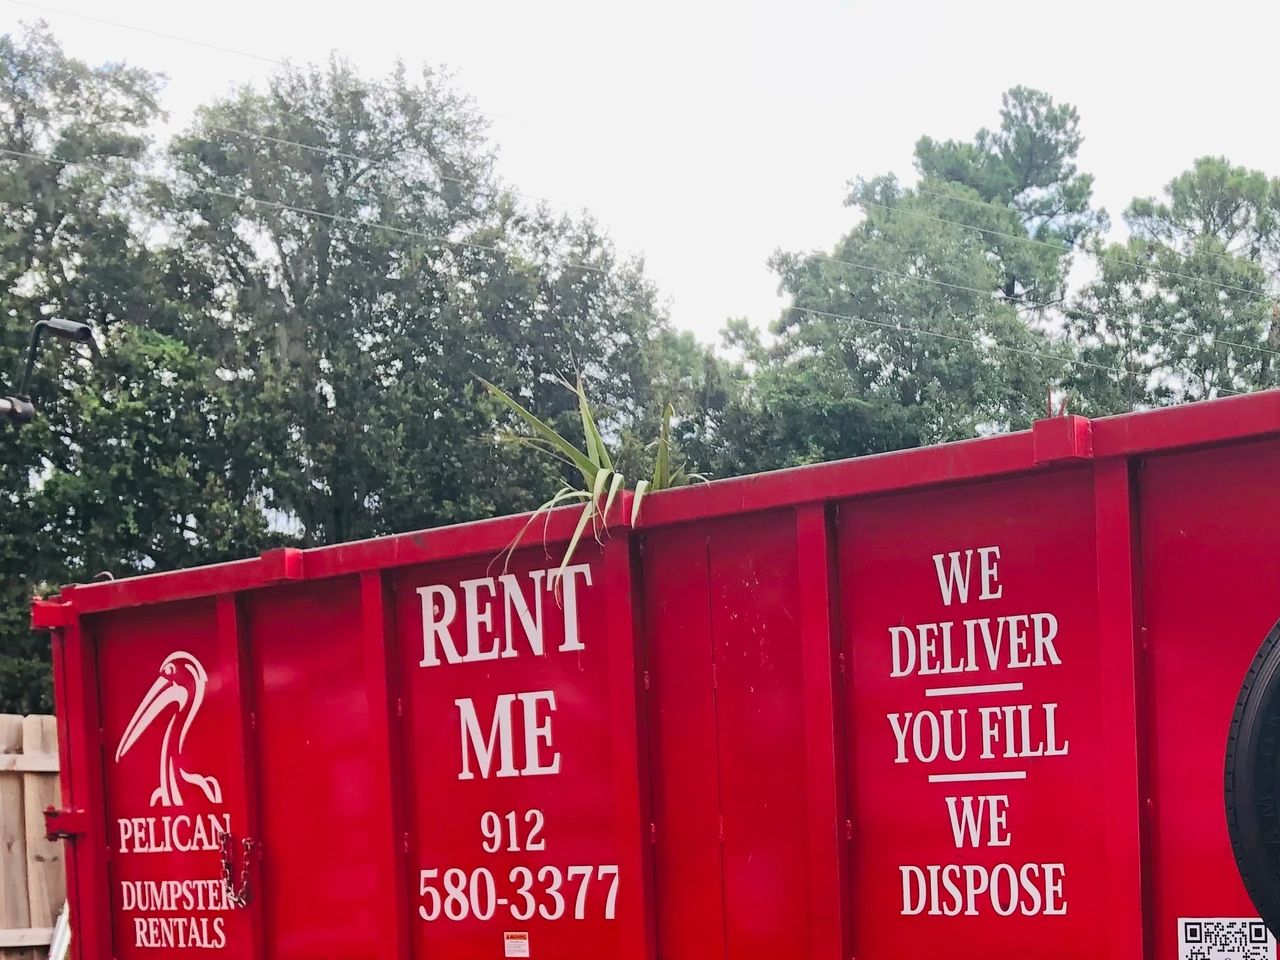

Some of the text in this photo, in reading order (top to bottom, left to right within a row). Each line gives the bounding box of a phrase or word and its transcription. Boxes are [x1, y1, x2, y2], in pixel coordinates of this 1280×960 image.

[932, 546, 1003, 606] WE
[416, 563, 593, 668] RENT
[888, 612, 1062, 678] DELIVER
[455, 690, 561, 780] ME
[887, 703, 1069, 764] YOU FILL
[118, 813, 231, 853] PELICAN
[480, 809, 545, 853] 912
[945, 794, 1011, 849] WE
[121, 879, 235, 911] DUMPSTER
[418, 864, 619, 921] 580-3377
[899, 863, 1067, 917] DISPOSE
[134, 917, 226, 949] RENTALS
